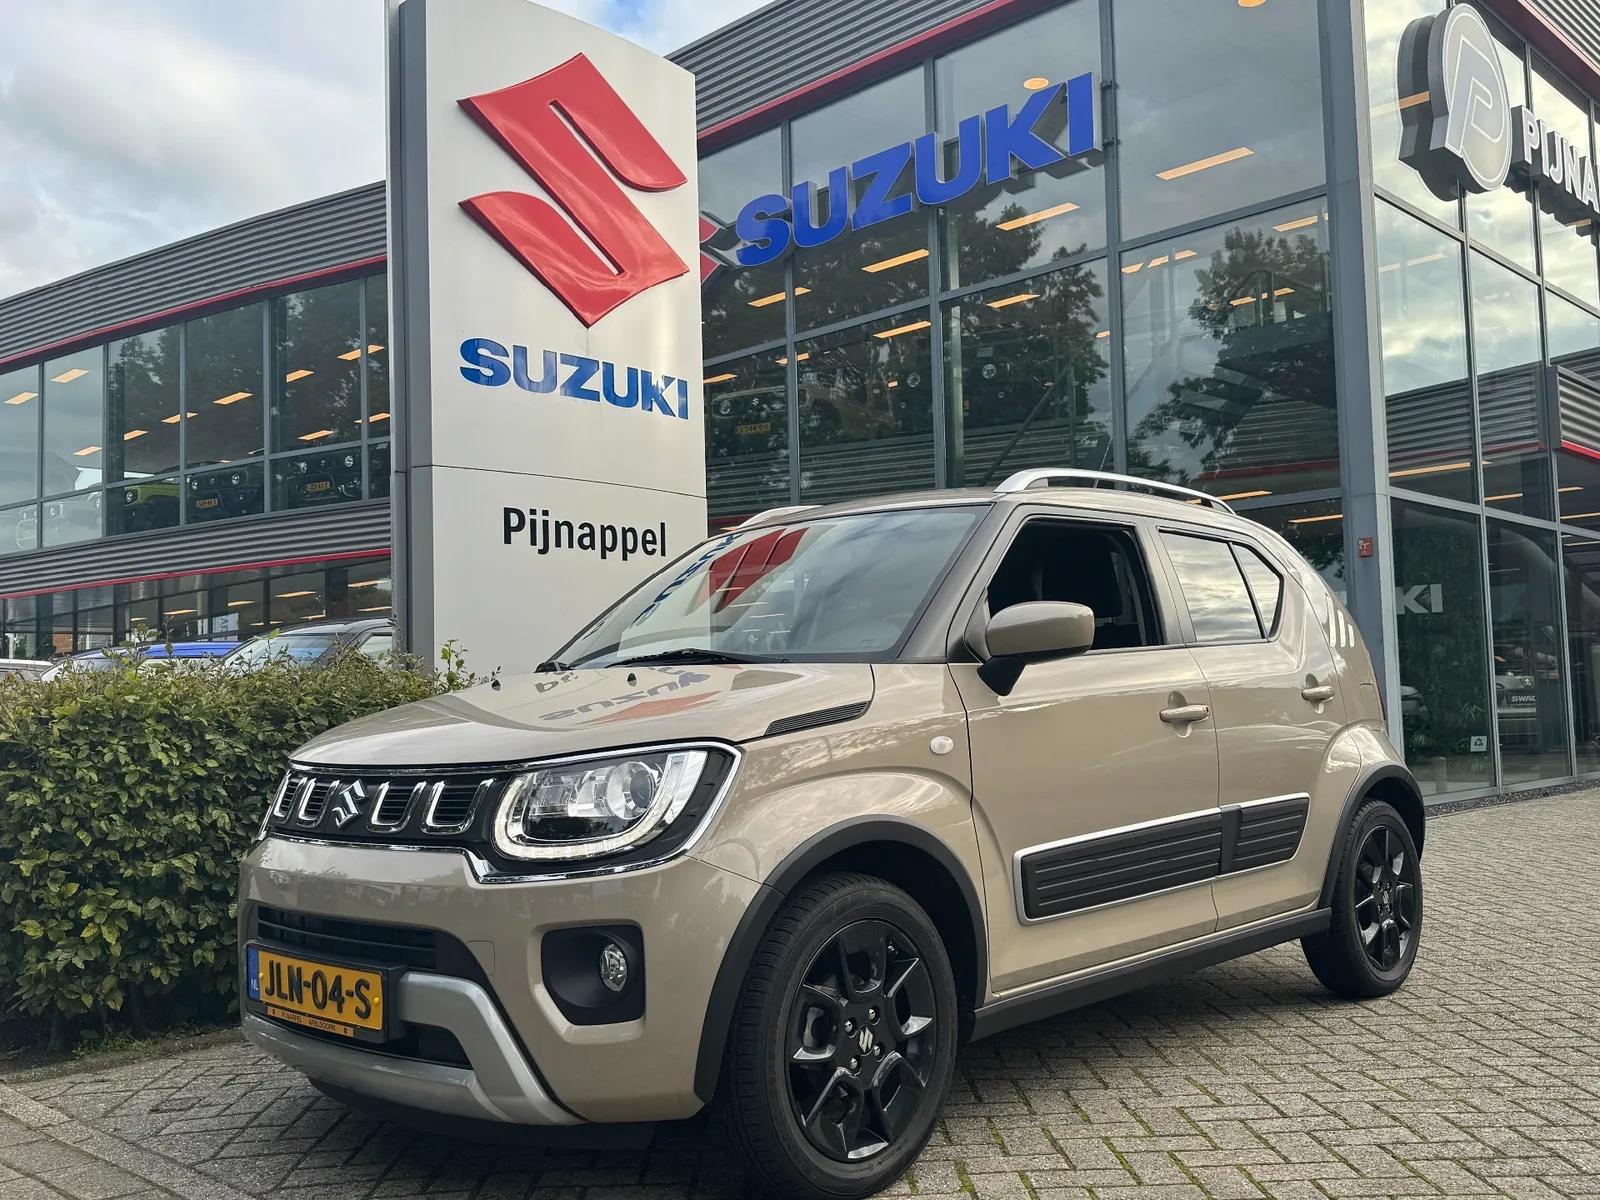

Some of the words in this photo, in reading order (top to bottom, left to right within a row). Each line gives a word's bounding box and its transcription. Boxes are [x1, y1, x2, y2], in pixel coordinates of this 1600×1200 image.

[735, 72, 1095, 267] SUZUKI
[459, 337, 689, 420] SUZUKI
[503, 507, 667, 562] Pijnappel
[250, 977, 260, 991] NL
[264, 959, 372, 1020] JLN-04-S
